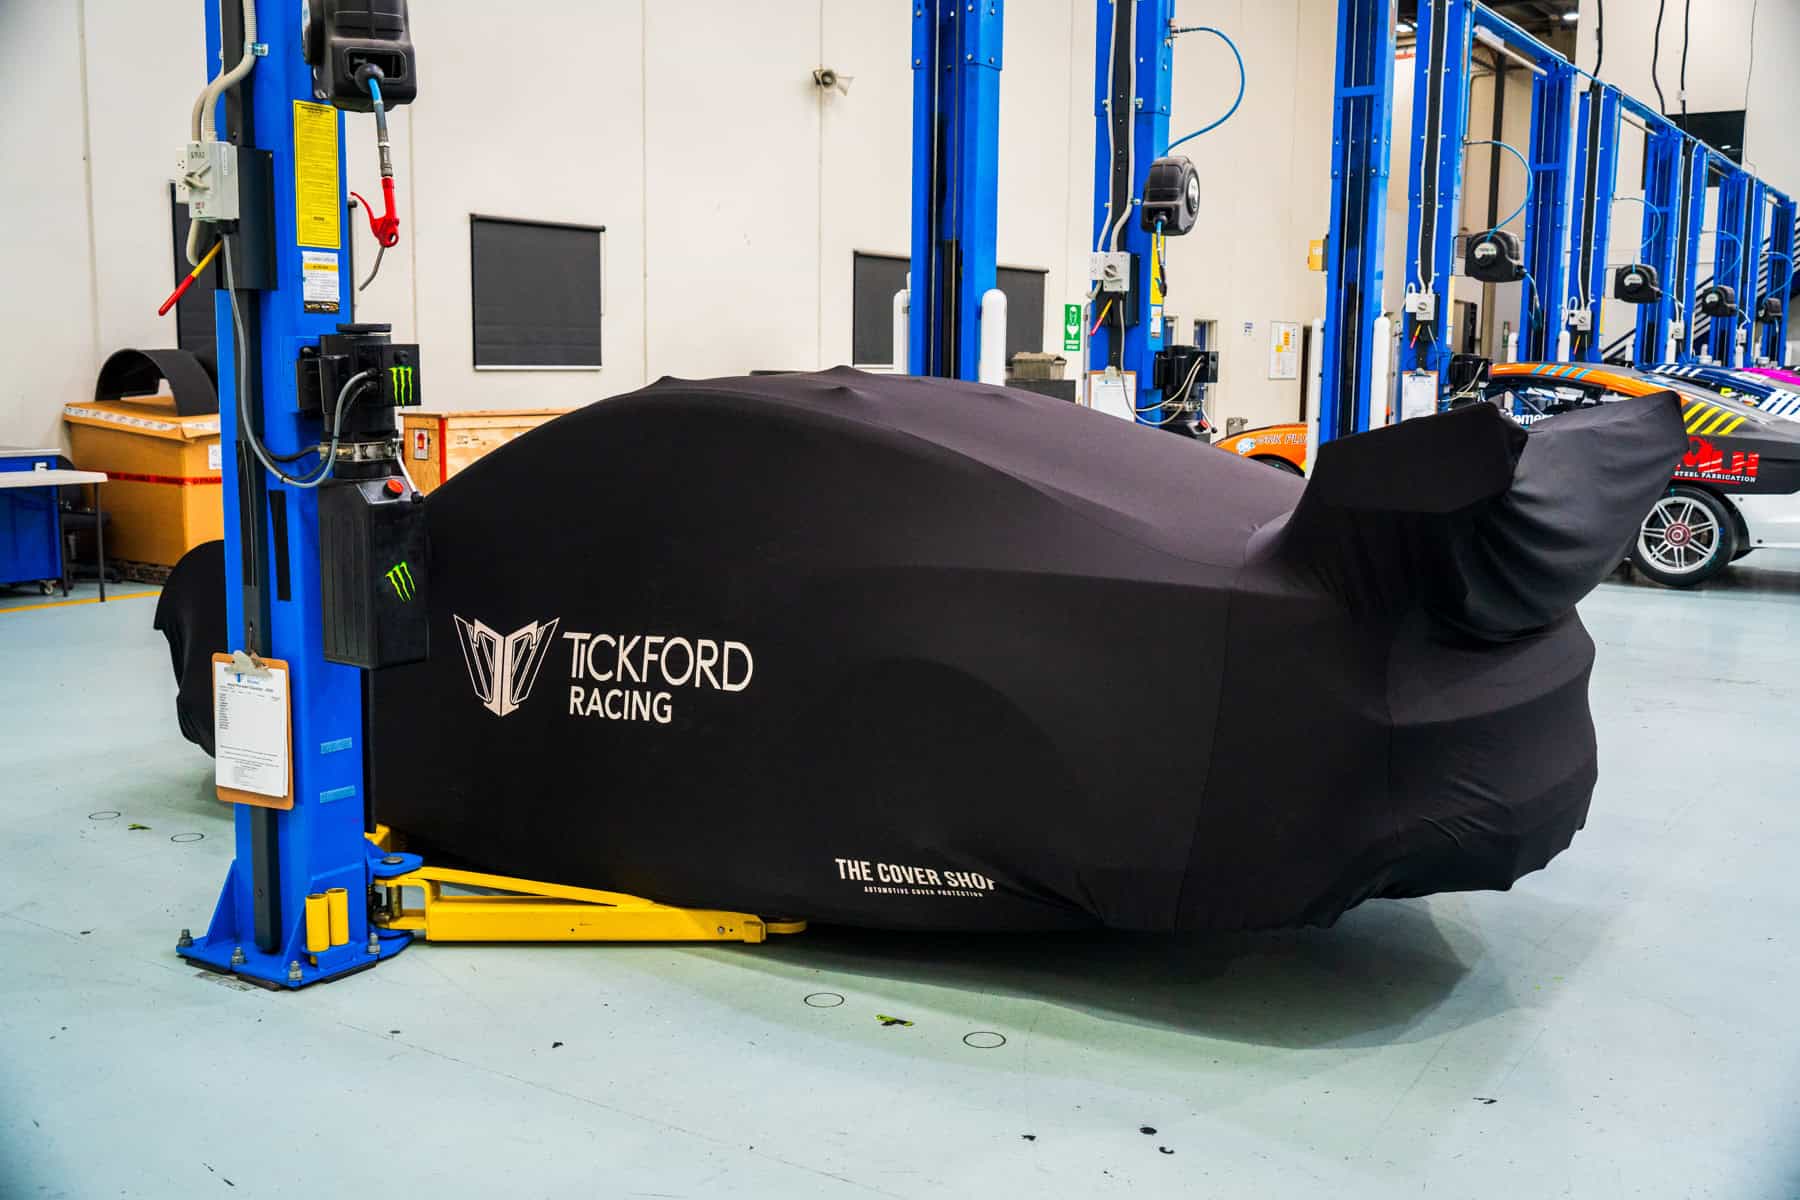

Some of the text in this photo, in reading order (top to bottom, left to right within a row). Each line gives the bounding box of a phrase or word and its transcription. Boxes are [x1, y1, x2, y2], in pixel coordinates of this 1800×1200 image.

[1701, 471, 1757, 483] FABRICATION
[562, 631, 754, 692] TICKFORD
[568, 685, 674, 724] RACING
[834, 858, 874, 881] THE
[877, 863, 942, 886] COVER
[864, 886, 910, 895] AUTOMOTIVE
